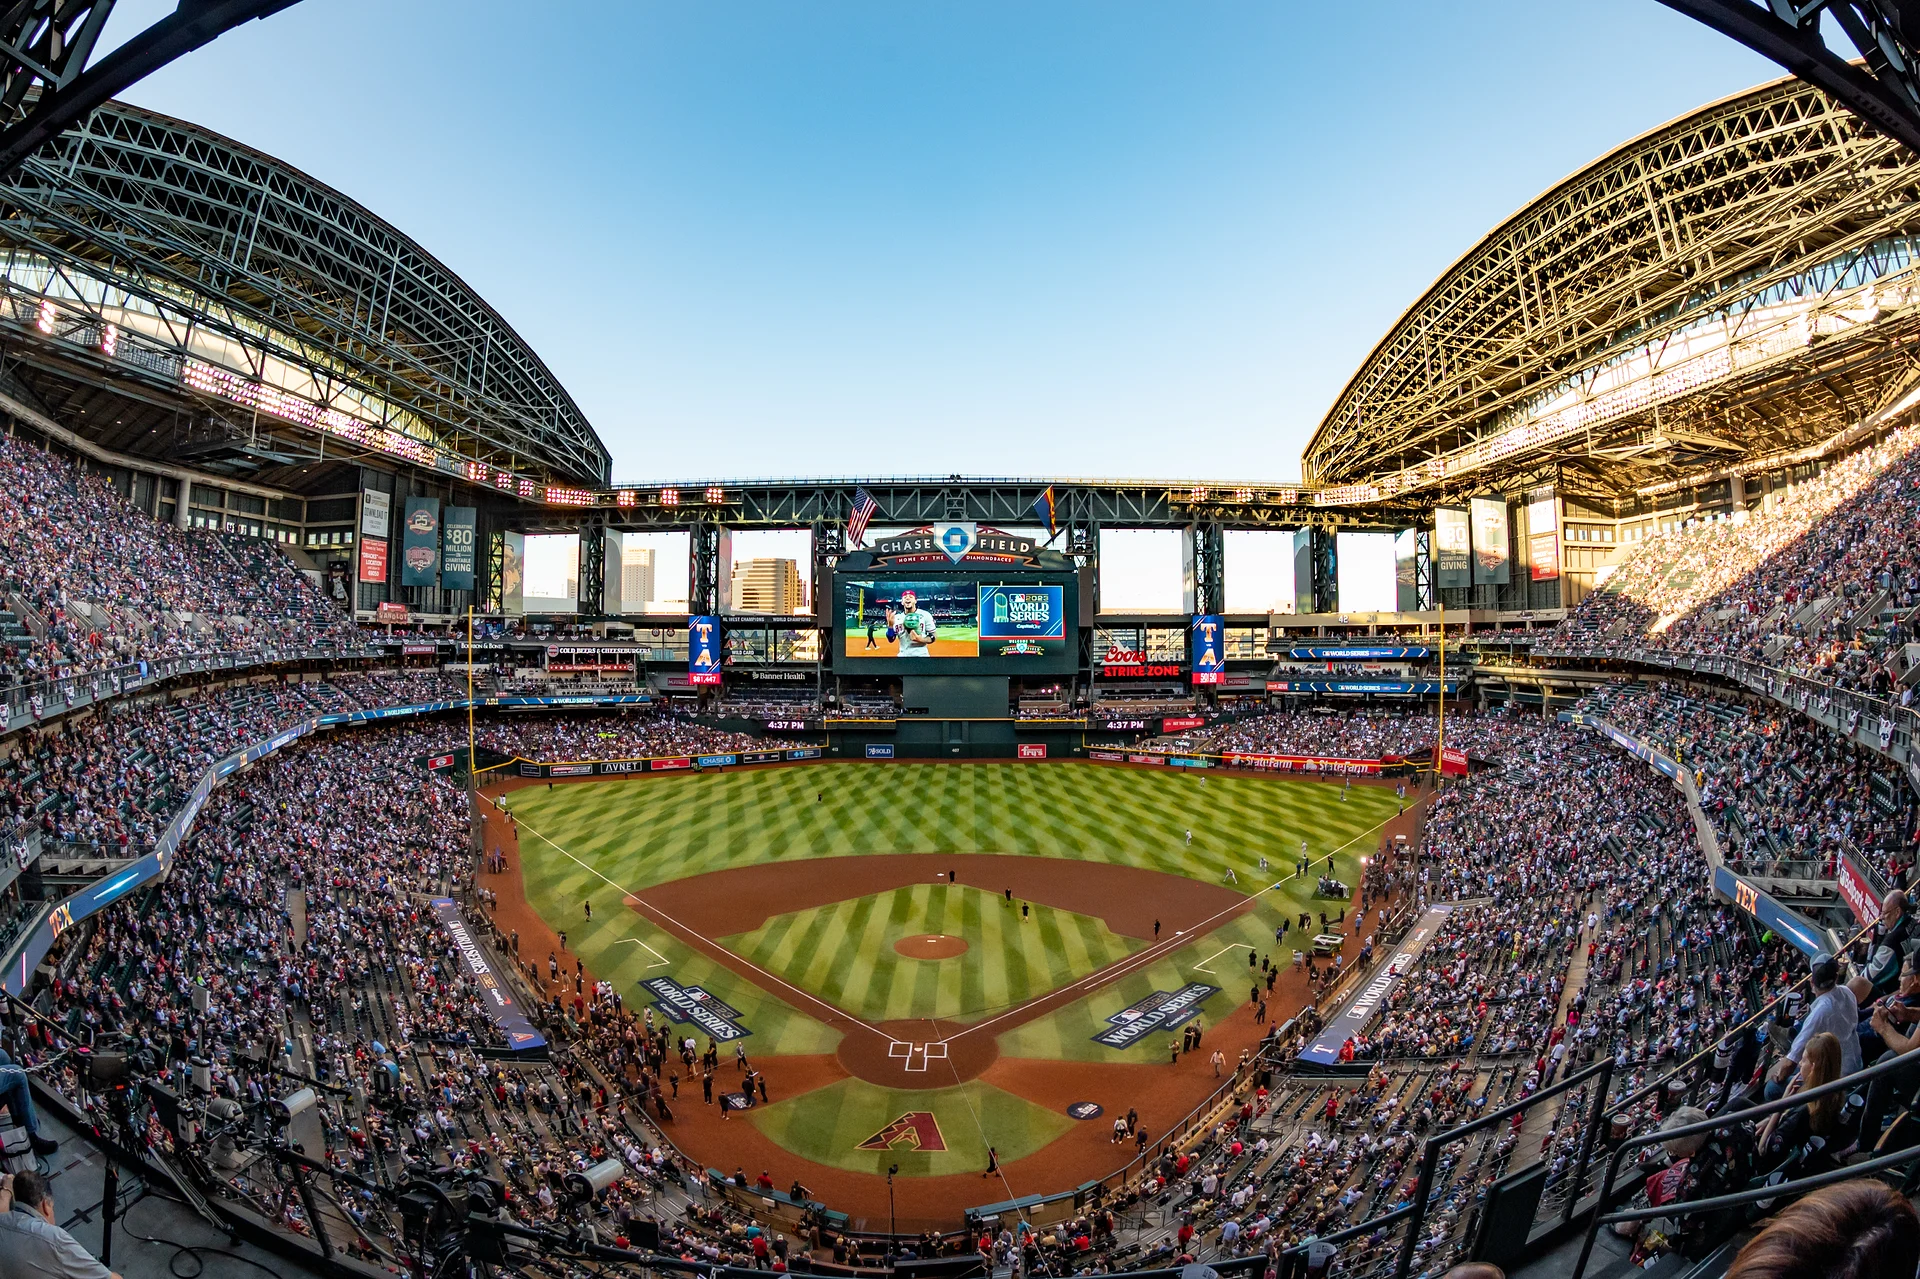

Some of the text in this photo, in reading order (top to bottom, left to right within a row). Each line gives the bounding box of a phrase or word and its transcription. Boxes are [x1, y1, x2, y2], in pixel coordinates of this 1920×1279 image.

[446, 529, 472, 545] $80
[446, 544, 472, 552] MILLION
[881, 538, 1030, 553] CHASE FIELD
[444, 564, 472, 572] GIVING
[1440, 561, 1468, 570] GIVING
[1010, 602, 1049, 612] WORLD
[1010, 612, 1050, 620] SERIES
[1338, 614, 1349, 624] 42
[696, 624, 712, 643] T
[1200, 623, 1217, 642] T
[694, 648, 713, 666] A
[1104, 646, 1184, 662] Coors LIGHT
[1198, 648, 1217, 666] A
[784, 672, 805, 680] Health
[1104, 666, 1180, 676] STRIKE ZONE
[768, 721, 804, 729] 4:37 PM
[1107, 721, 1128, 729] 4:37
[1021, 746, 1043, 756] fry's
[606, 762, 638, 771] AVNET
[1735, 880, 1759, 916] TEX
[48, 901, 74, 939] TEX
[452, 927, 475, 954] WORLD
[464, 950, 490, 974] SERIES
[1356, 974, 1392, 1006] WORLD
[650, 978, 741, 1039] WORLD SERIES
[702, 1000, 734, 1018] 2023
[1136, 992, 1170, 1011] 2023
[1102, 984, 1211, 1044] WORLD SERIES
